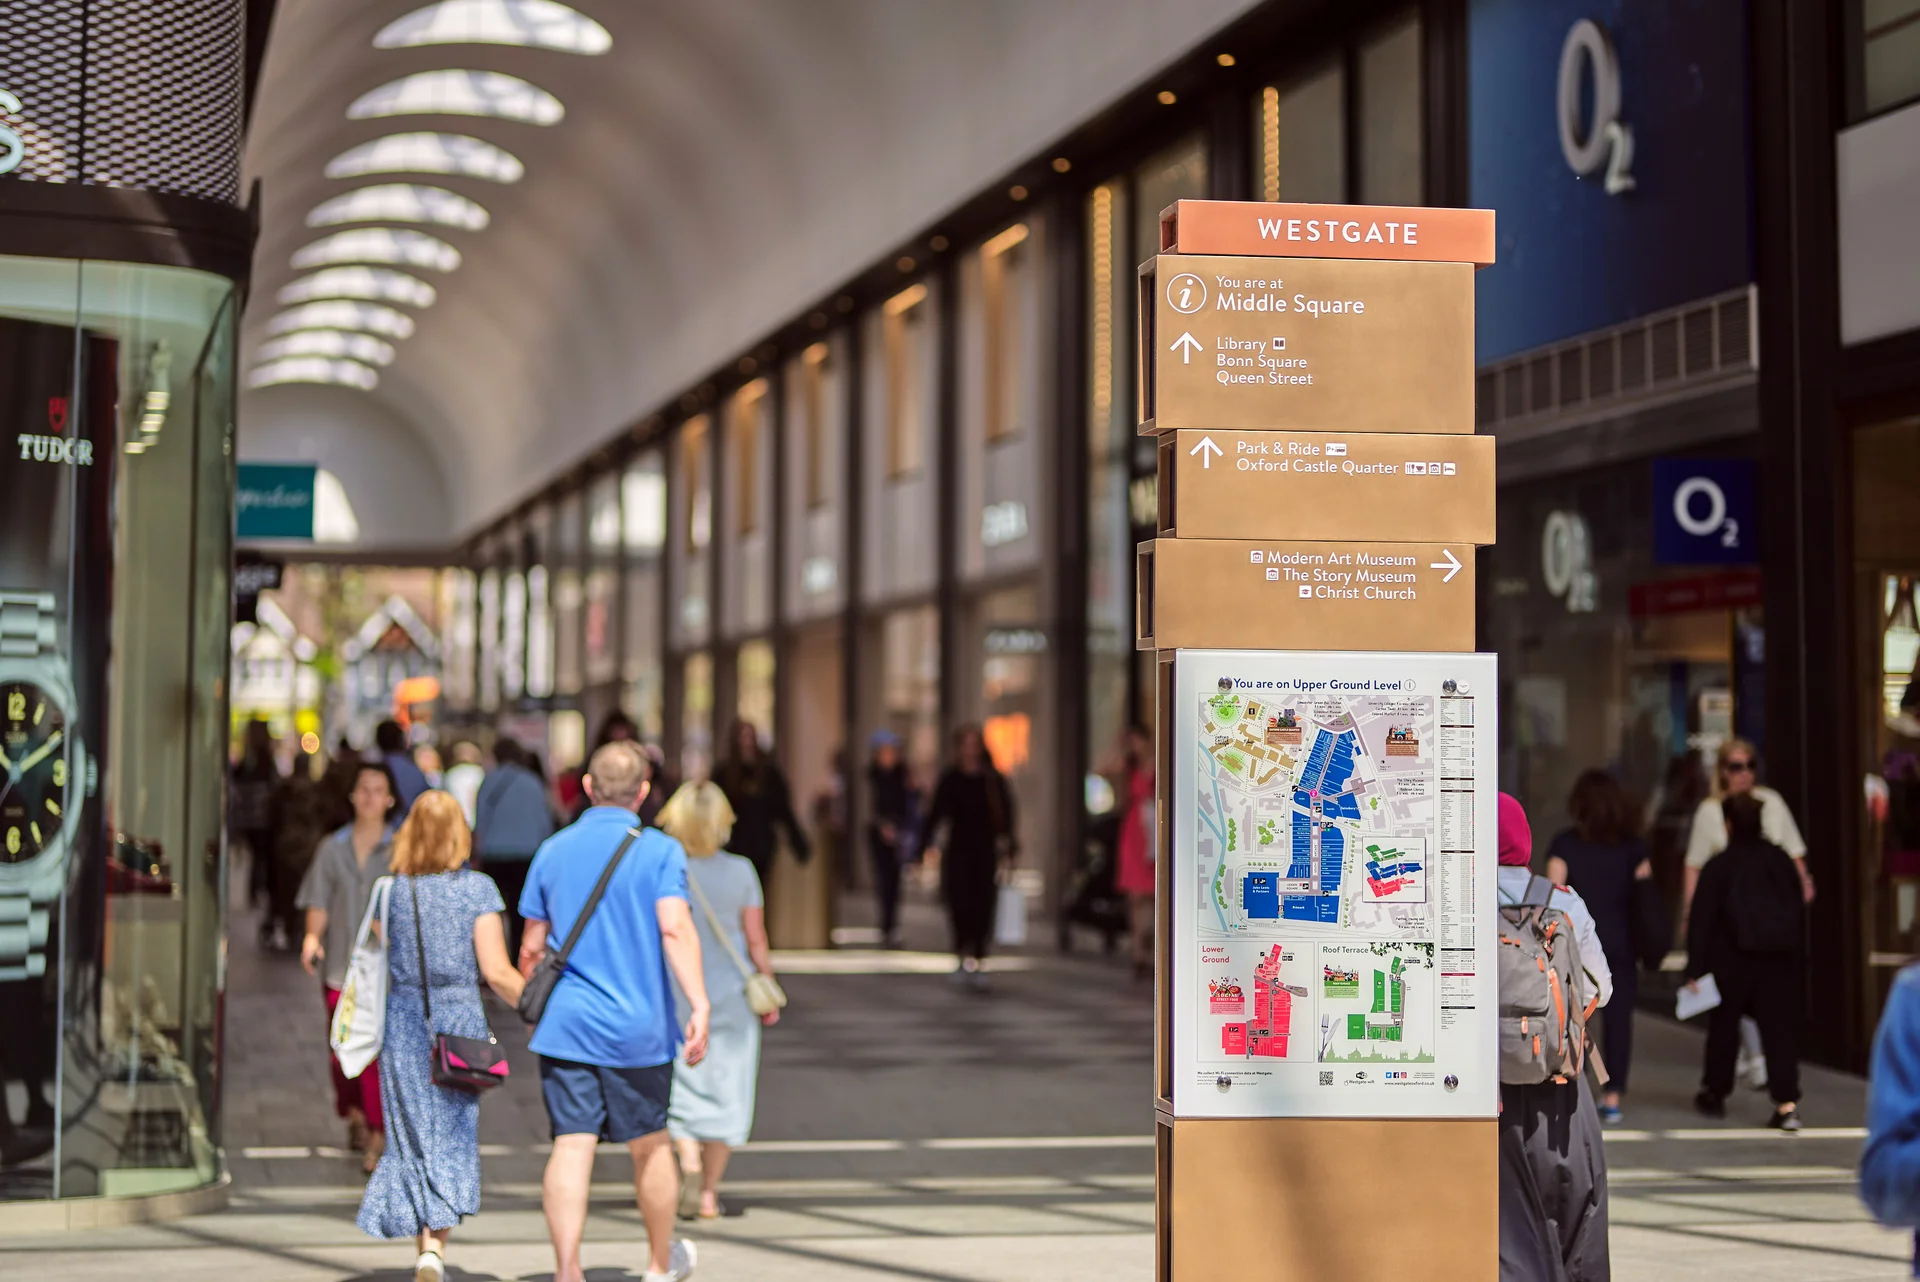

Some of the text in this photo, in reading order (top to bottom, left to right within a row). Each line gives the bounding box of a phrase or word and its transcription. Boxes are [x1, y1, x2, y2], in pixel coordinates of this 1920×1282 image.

[1257, 218, 1418, 245] WESTGATE
[1216, 276, 1283, 288] You are at
[1217, 293, 1364, 318] Middle Square
[1218, 337, 1266, 355] Library
[1218, 354, 1307, 371] Bonn Square
[1217, 371, 1312, 386] Queen Street
[18, 434, 93, 466] TUDOR
[1238, 441, 1268, 454] Park
[1274, 442, 1283, 454] &
[1289, 442, 1320, 455] Ride
[1237, 458, 1399, 476] Oxford Castle Quarter
[1673, 476, 1739, 547] O2
[1268, 551, 1415, 565] Modern Art Museum
[1284, 568, 1415, 585] The Story Museum
[1316, 586, 1415, 599] Christ Church
[1233, 678, 1401, 692] You are on Upper Ground Level
[8, 692, 26, 721] 12
[1202, 945, 1224, 953] Lower
[1342, 946, 1369, 954] Terrace
[1202, 955, 1230, 963] Ground
